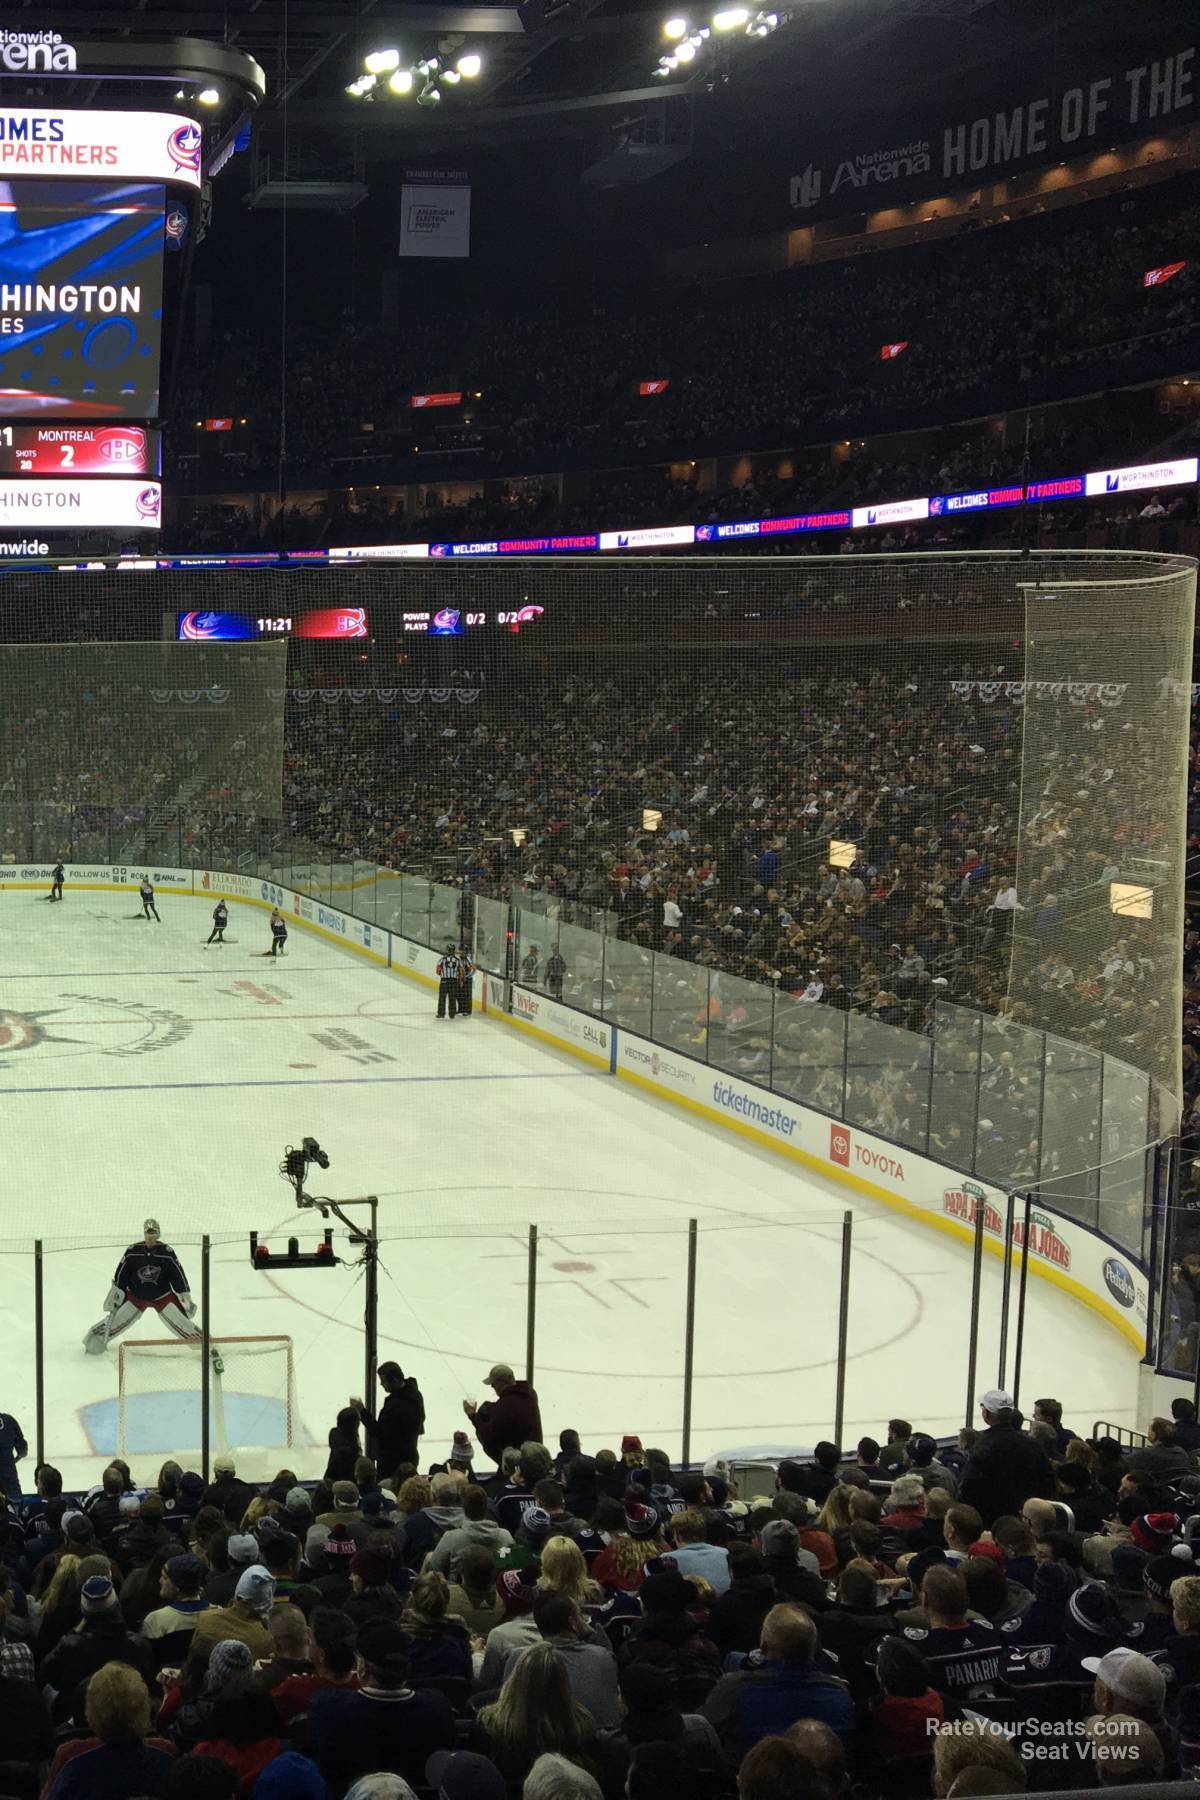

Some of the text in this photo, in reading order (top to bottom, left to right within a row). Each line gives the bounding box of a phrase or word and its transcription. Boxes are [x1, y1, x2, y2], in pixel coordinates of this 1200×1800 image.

[943, 47, 1196, 177] HOME OF THE
[1, 143, 118, 165] PARTNERS
[856, 139, 929, 168] Nationwide
[830, 153, 931, 194] Arena
[38, 430, 96, 442] MONTREAL
[15, 450, 37, 458] SHOTS
[60, 445, 75, 467] 2
[1121, 468, 1174, 483] WORTHINGTON
[947, 493, 988, 510] WELCOMES
[1037, 479, 1082, 498] PARTNERS
[718, 512, 849, 537] WELCOMES COMMUNITY PARTNERS
[453, 535, 596, 555] WELCOMES COMMUNITY PARTNERS
[257, 618, 292, 631] 11:21
[403, 611, 518, 625] POWER 0/2 0/2
[404, 622, 428, 631] PLAYS
[130, 869, 146, 879] #CB
[624, 1046, 696, 1084] VECTOR SECURITY
[713, 1080, 797, 1137] ticketmaster
[854, 1144, 905, 1182] TOYOTA
[945, 1191, 968, 1219] PAPA
[1105, 1263, 1134, 1301] Pedialyte
